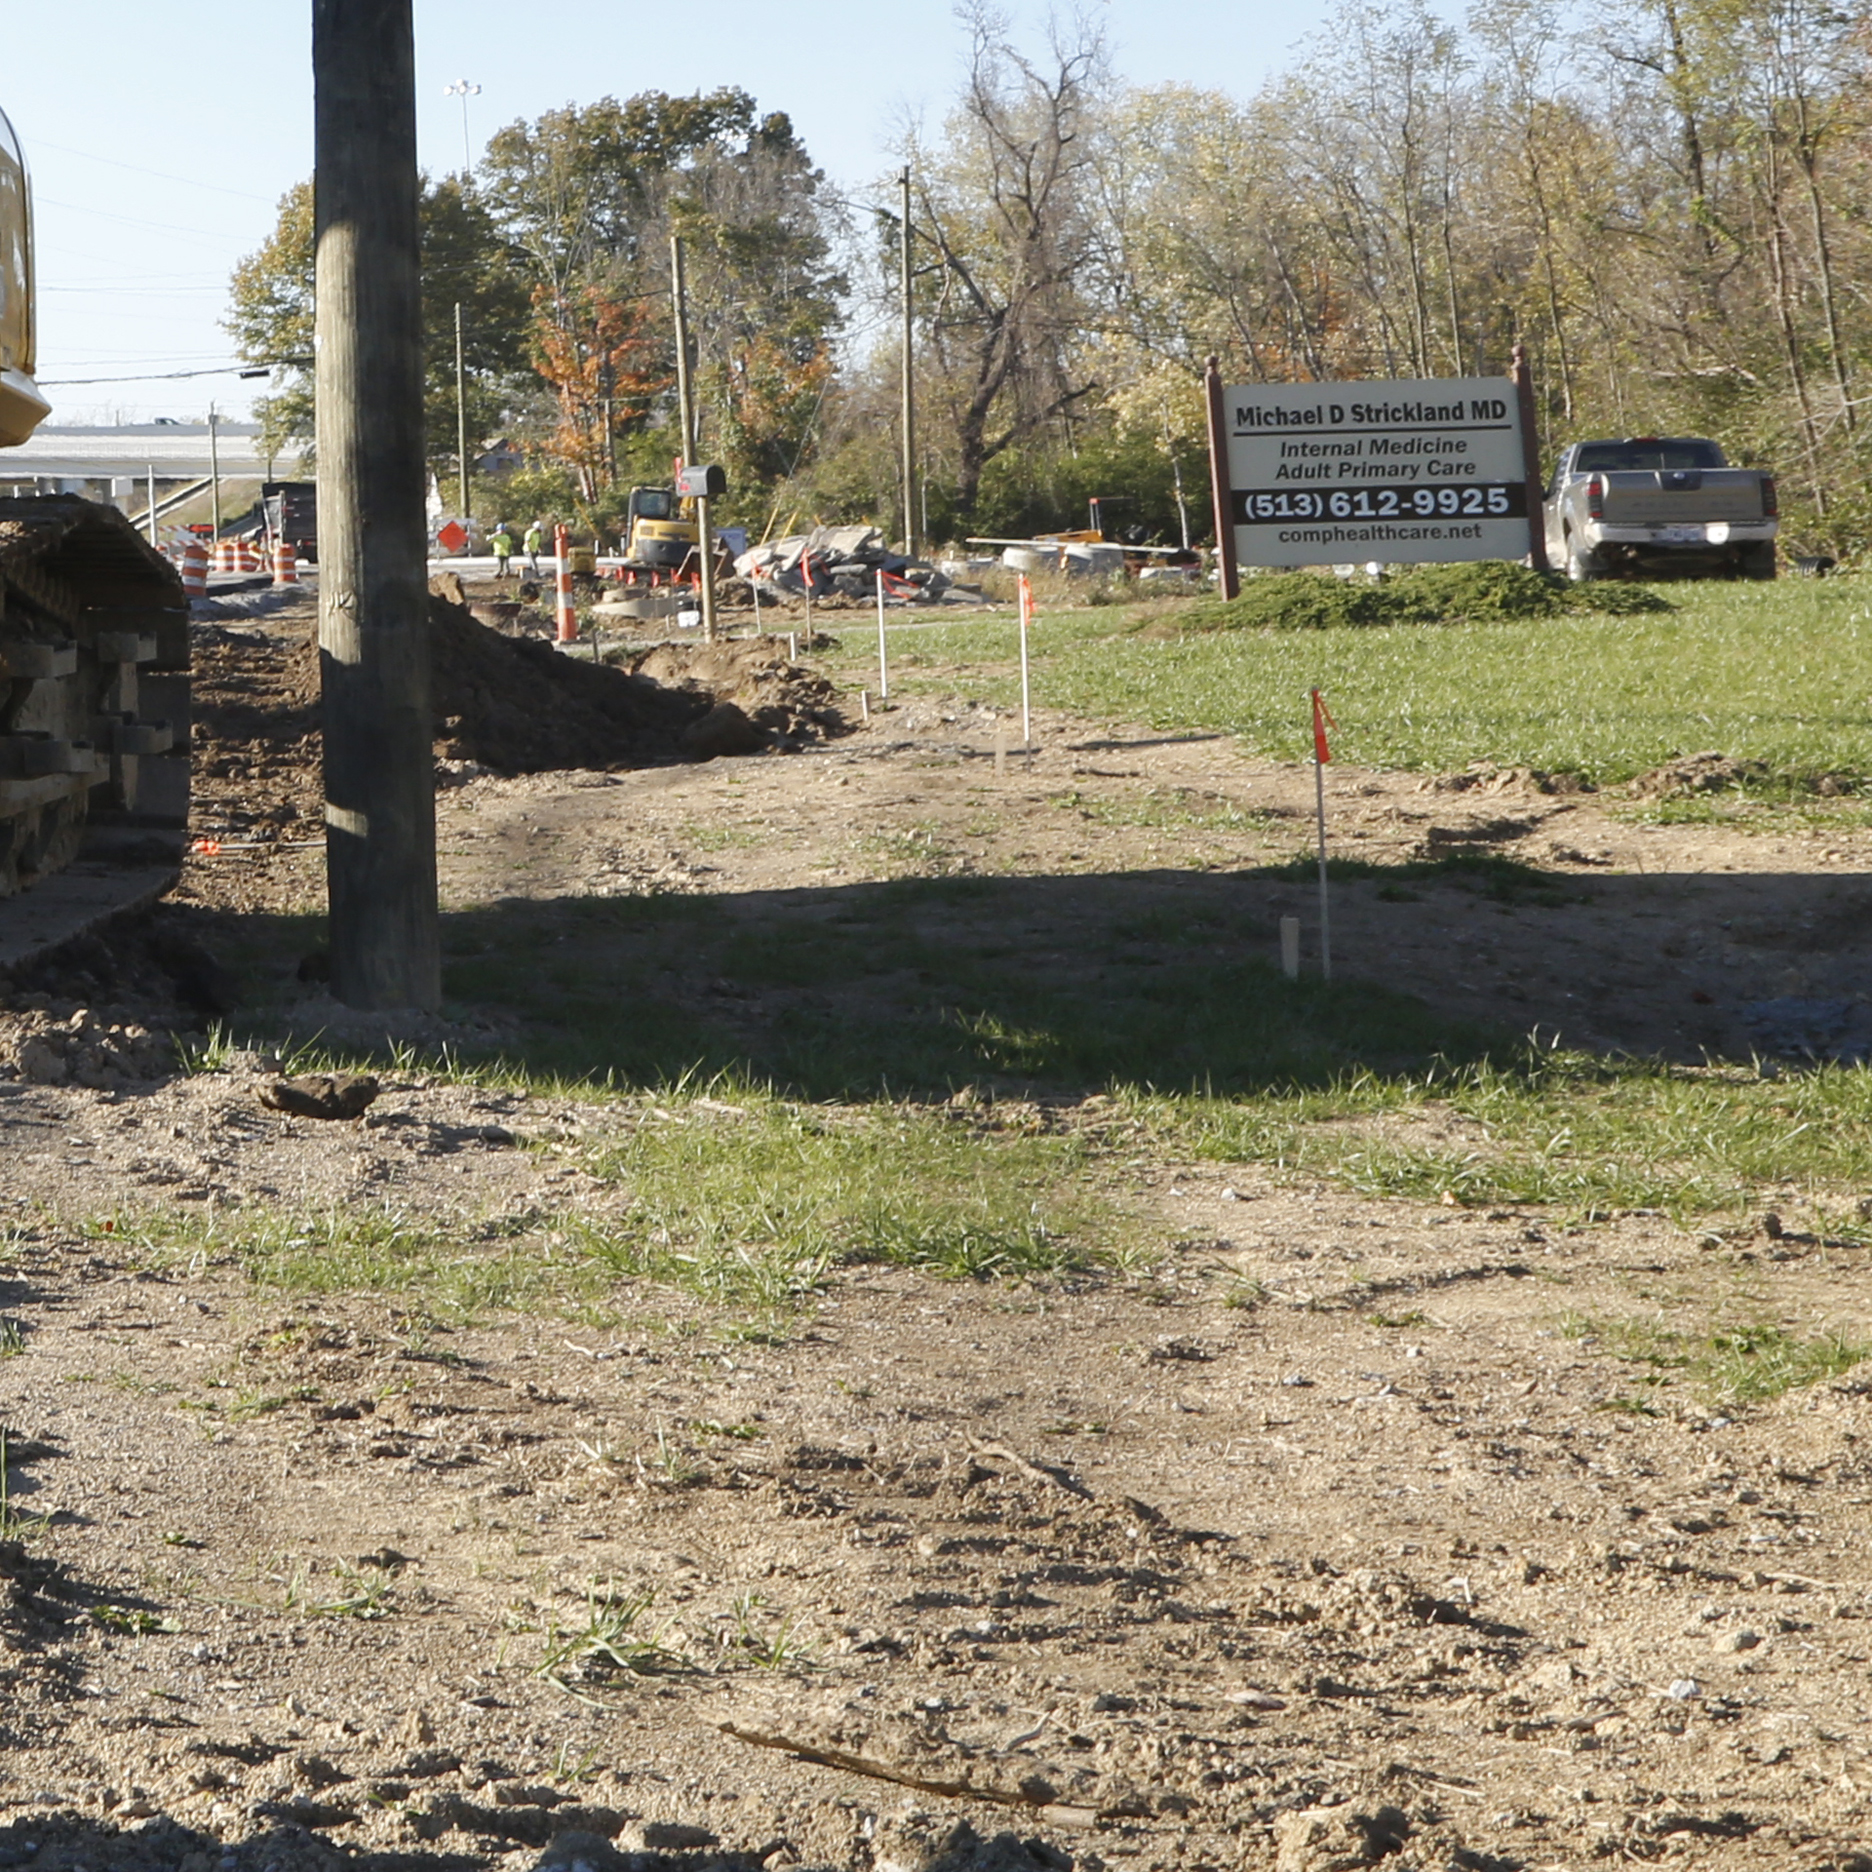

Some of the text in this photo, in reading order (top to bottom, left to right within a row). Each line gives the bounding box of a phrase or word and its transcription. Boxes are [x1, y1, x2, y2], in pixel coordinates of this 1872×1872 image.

[1237, 400, 1506, 427] Michael D Strickland MD
[1281, 438, 1467, 458] Internal Medicine
[1276, 460, 1476, 480] Adult Primary Care
[1245, 488, 1509, 519] (513) 612-9925
[1279, 523, 1482, 544] comphealthcare.net
